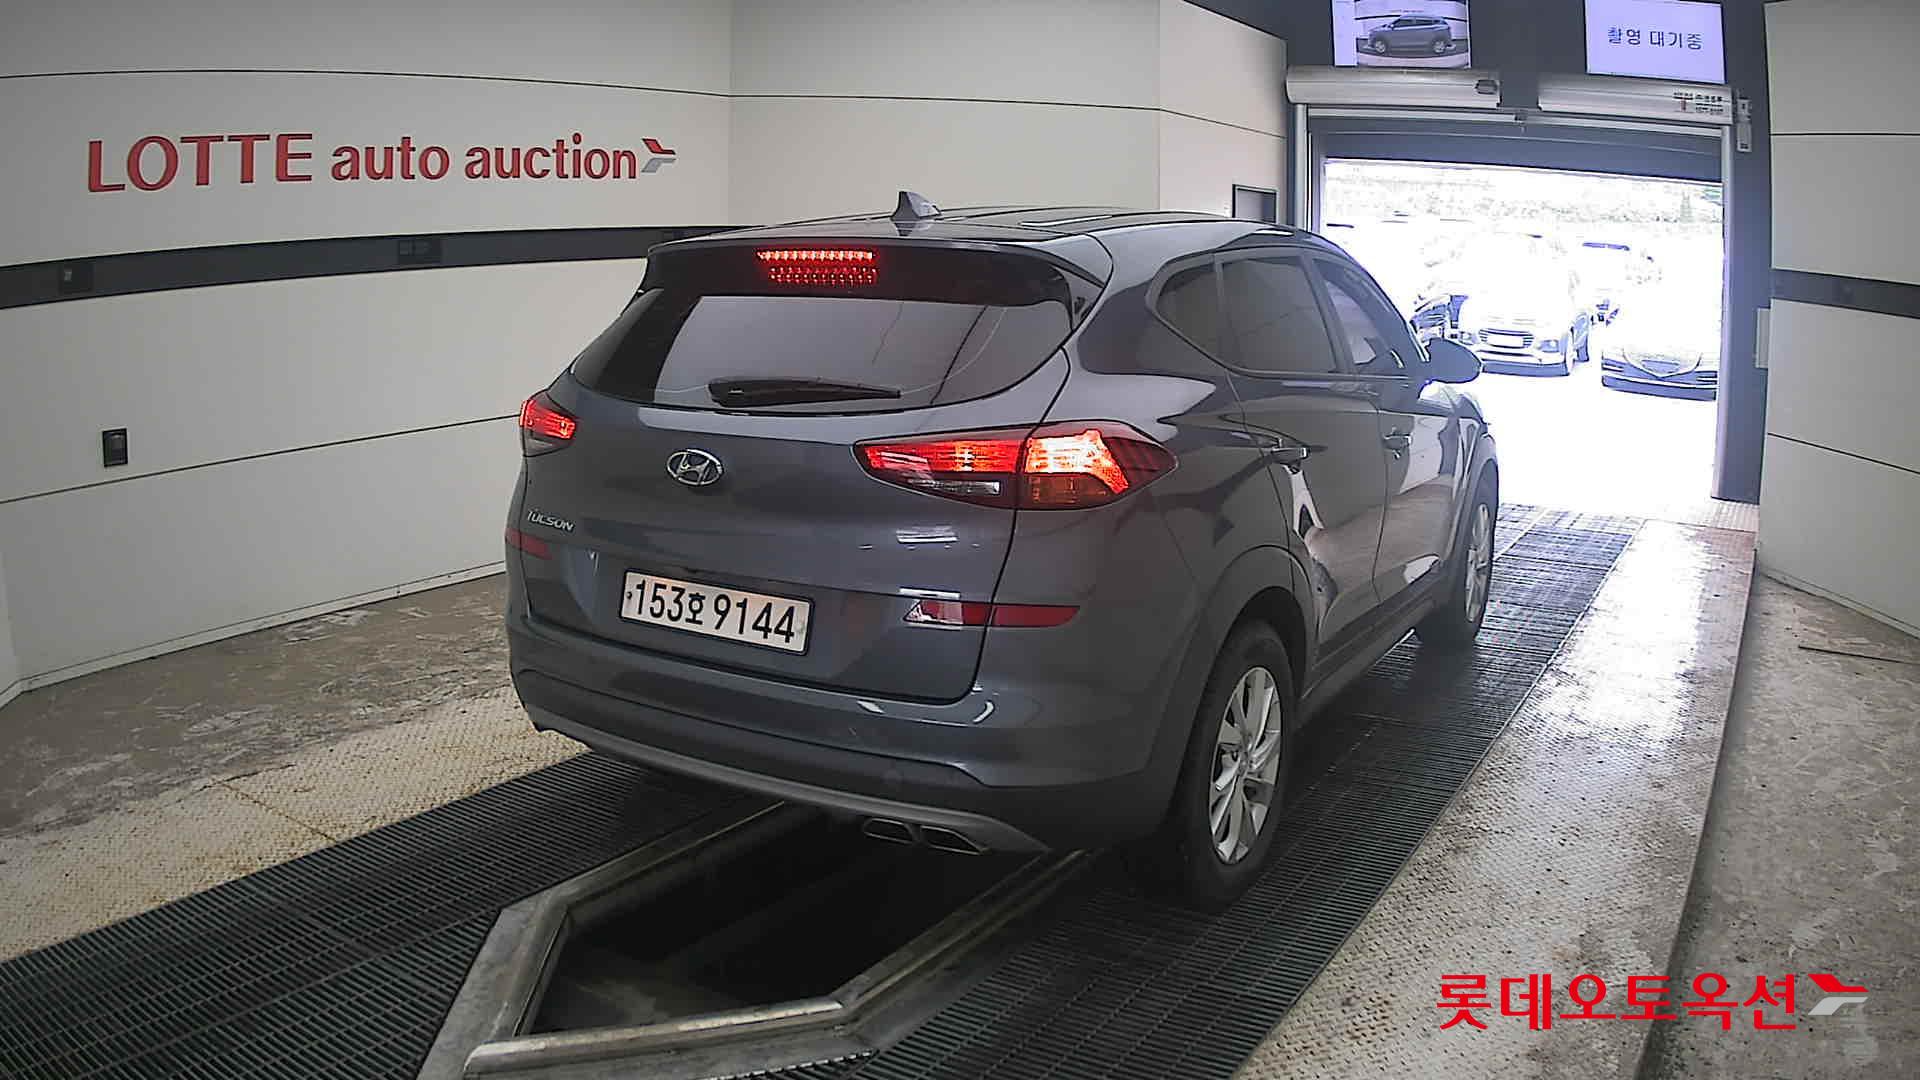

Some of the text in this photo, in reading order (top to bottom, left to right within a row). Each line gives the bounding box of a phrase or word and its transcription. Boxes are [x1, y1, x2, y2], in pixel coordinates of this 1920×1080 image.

[1650, 31, 1702, 50] 대기중
[88, 132, 637, 193] LOTTE auto auction
[635, 579, 796, 644] 153호 9144
